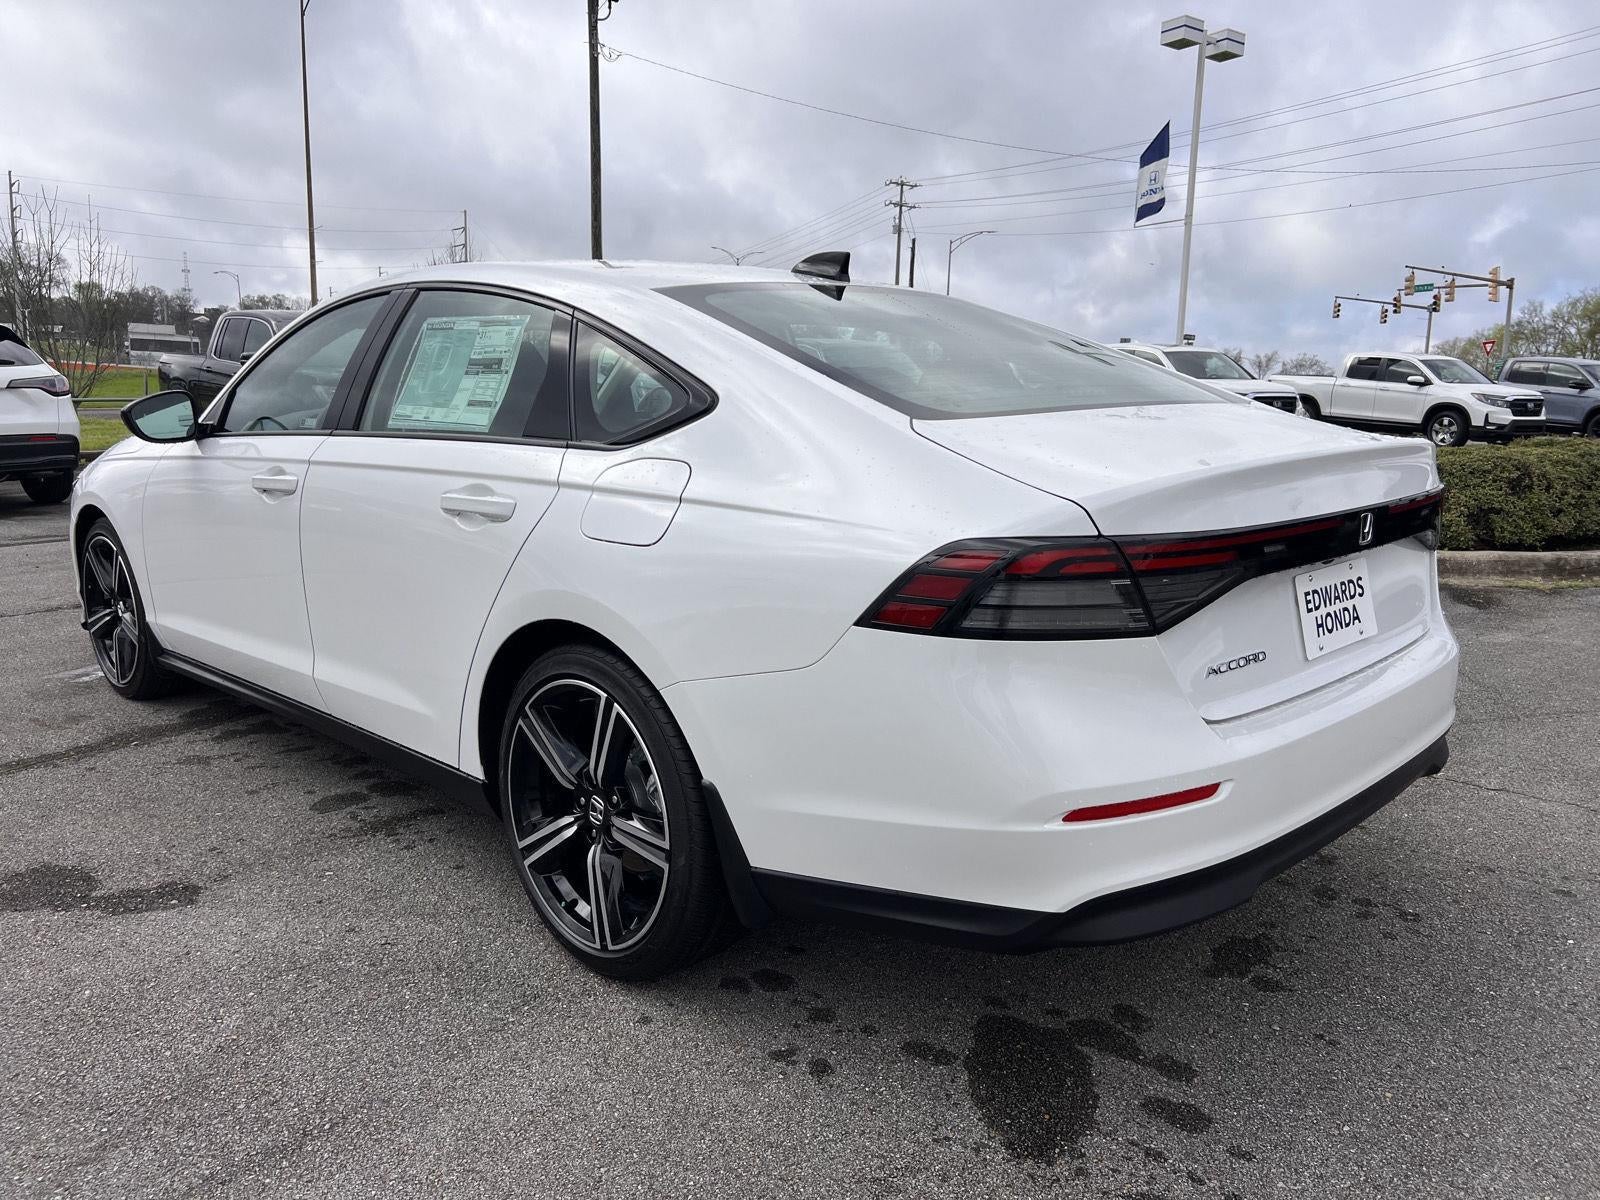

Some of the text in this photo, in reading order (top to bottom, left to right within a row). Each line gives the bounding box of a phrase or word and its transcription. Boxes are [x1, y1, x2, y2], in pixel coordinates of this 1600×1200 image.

[1304, 576, 1365, 614] EDWARDS
[1315, 604, 1361, 638] HONDA
[1204, 651, 1267, 680] ACCORD
